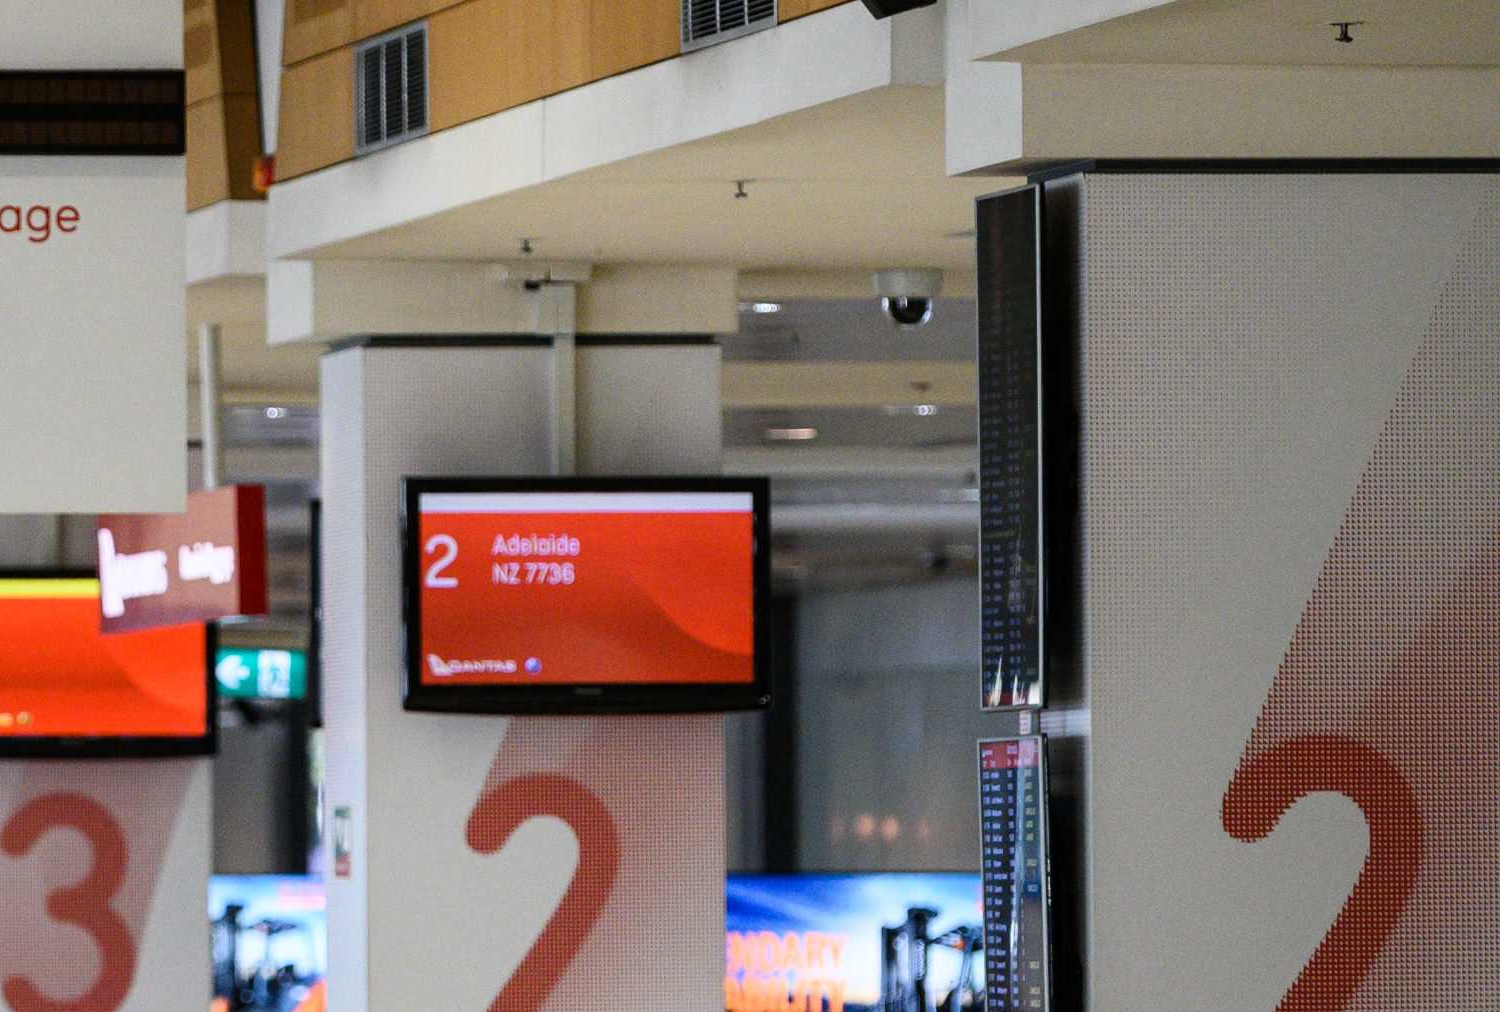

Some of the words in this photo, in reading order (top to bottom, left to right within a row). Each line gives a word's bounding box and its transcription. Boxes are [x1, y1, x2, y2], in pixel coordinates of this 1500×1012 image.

[491, 533, 581, 556] Adelaide
[424, 532, 459, 589] 2
[491, 562, 522, 585] NZ
